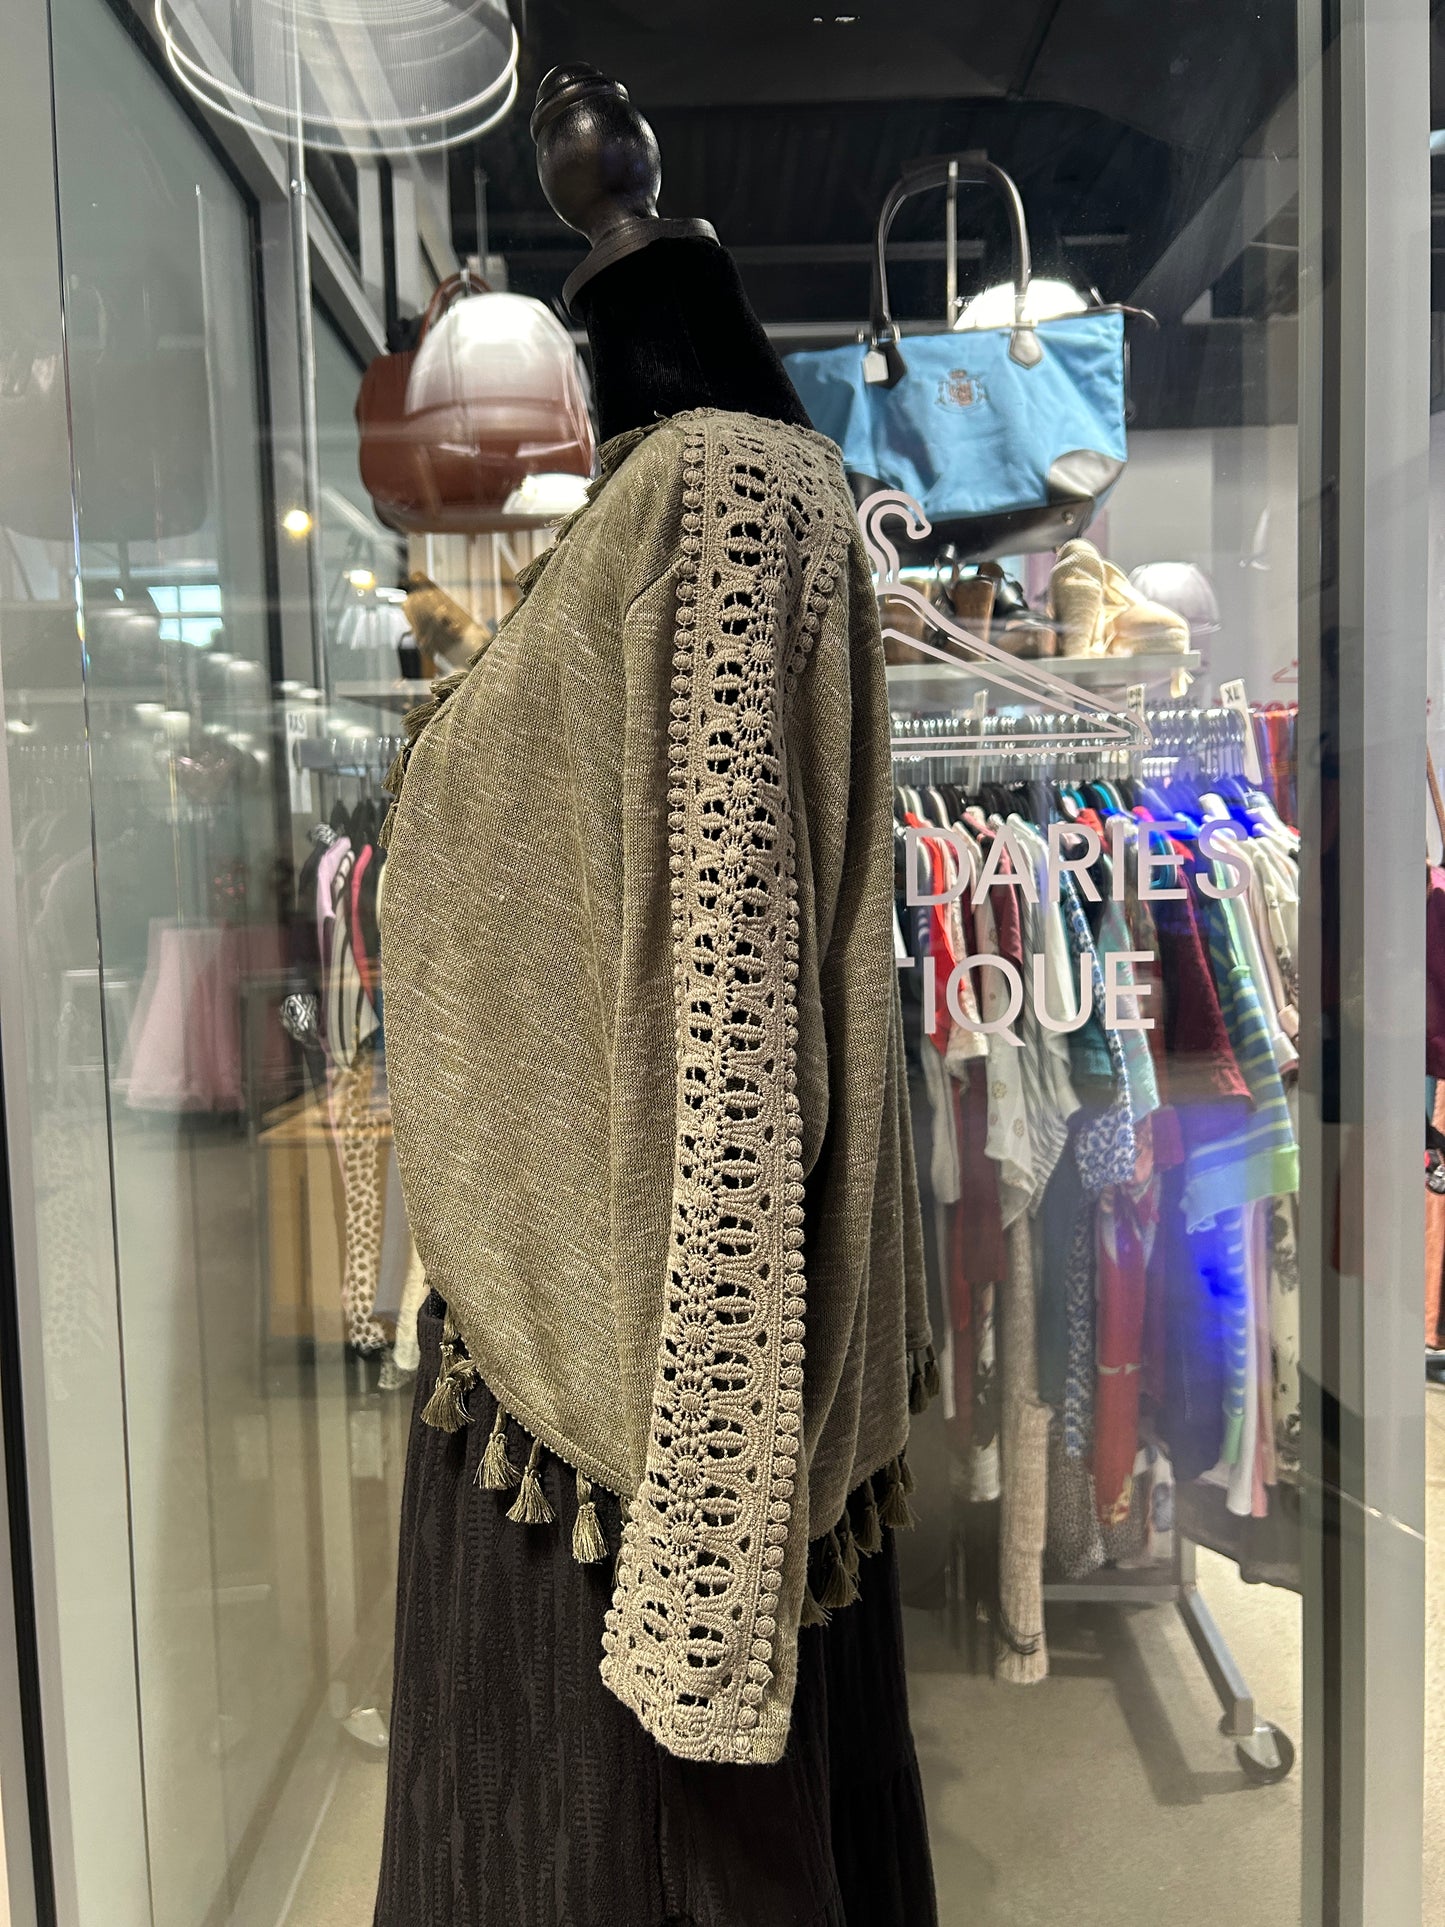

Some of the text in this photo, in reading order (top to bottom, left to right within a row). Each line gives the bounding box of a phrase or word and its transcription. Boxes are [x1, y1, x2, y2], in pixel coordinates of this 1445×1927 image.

[1224, 686, 1241, 702] XL
[905, 819, 1252, 906] DARIES
[896, 950, 1156, 1047] IQUE
